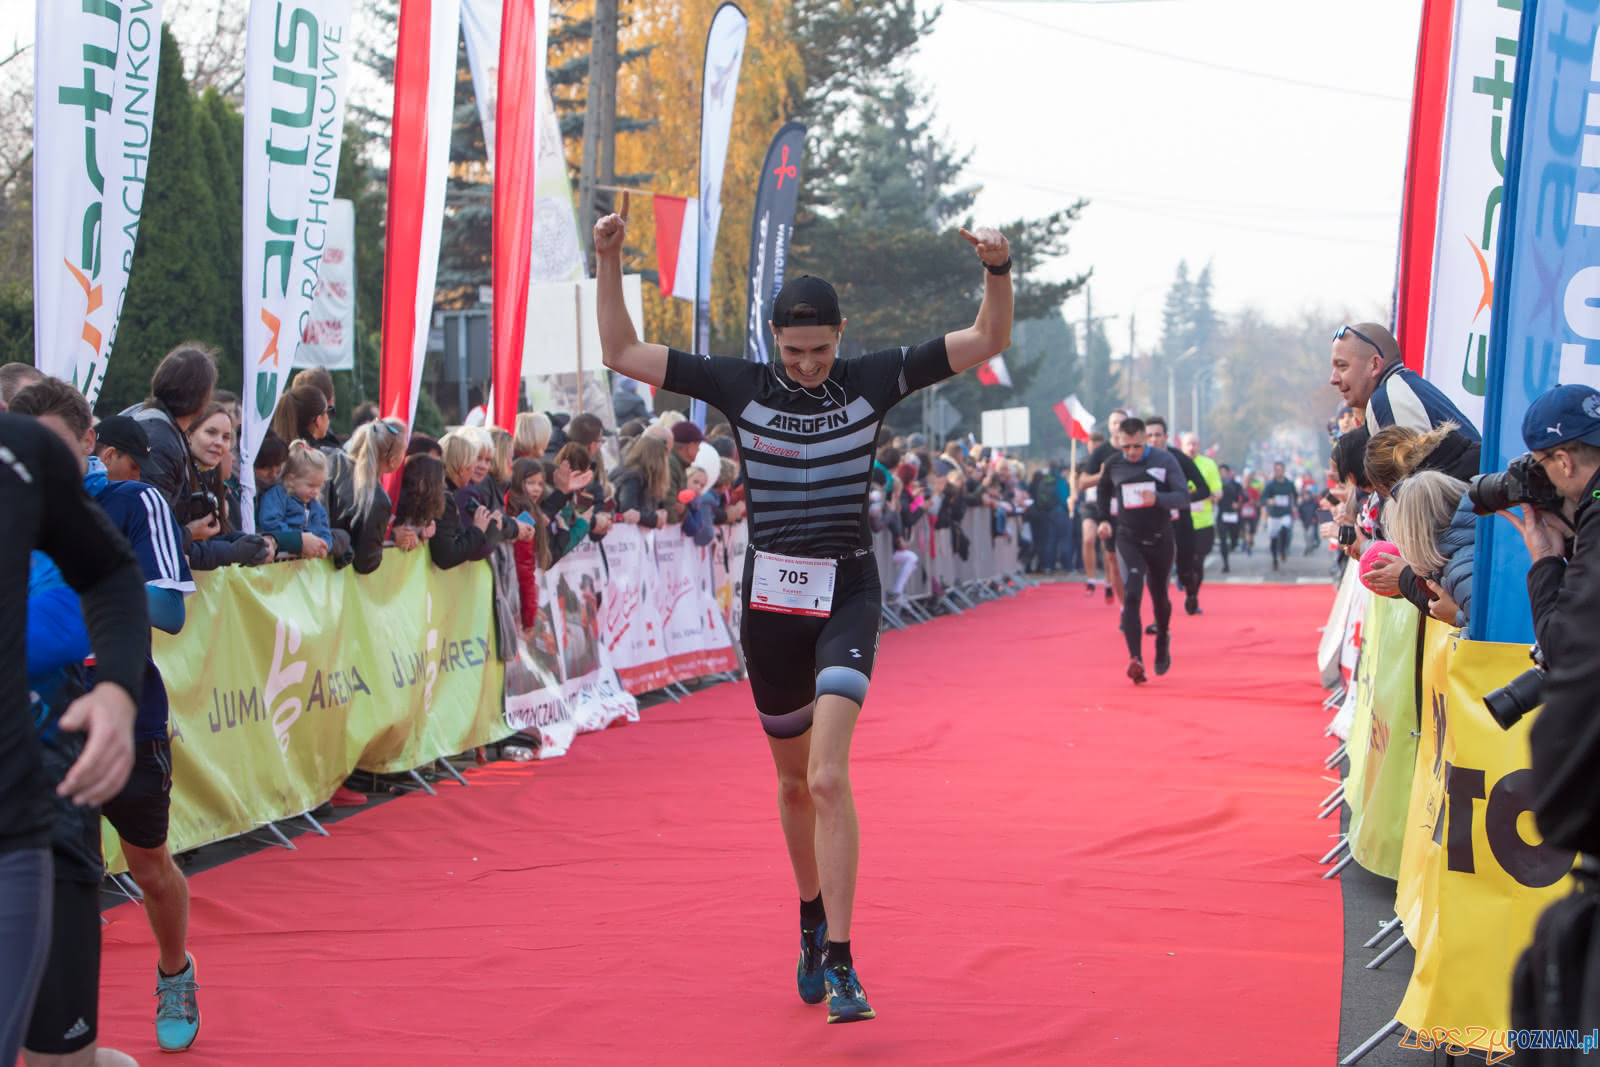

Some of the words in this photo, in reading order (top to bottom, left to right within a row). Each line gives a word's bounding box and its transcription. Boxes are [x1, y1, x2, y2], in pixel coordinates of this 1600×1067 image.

[301, 20, 342, 300] RACHUNKOWE
[767, 410, 849, 433] AIROFIN
[778, 569, 809, 585] 705
[208, 686, 267, 734] JUMI
